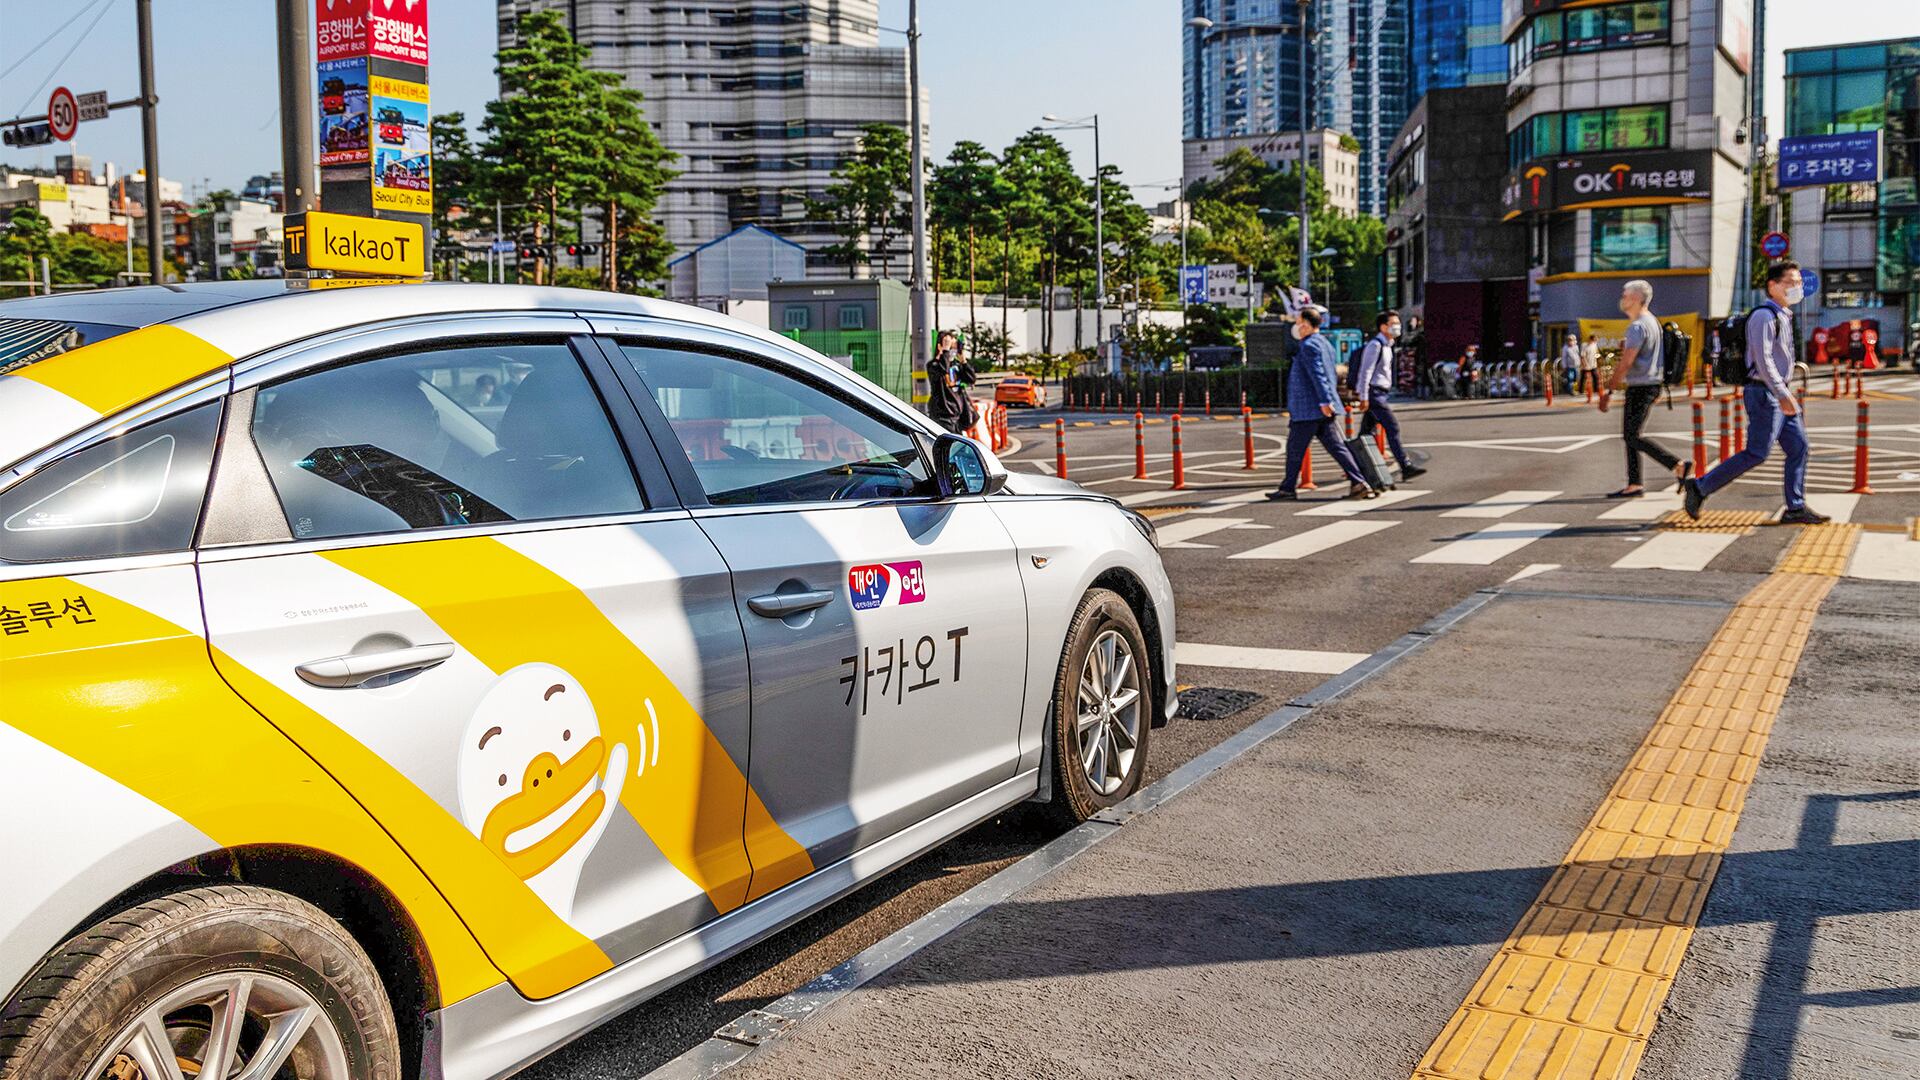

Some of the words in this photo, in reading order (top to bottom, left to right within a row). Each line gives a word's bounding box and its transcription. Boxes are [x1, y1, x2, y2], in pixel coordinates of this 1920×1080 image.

[319, 17, 366, 44] 공항버스
[373, 15, 427, 48] 공항버스
[319, 43, 349, 55] AIRPORT
[350, 41, 366, 51] BUS
[374, 41, 409, 57] AIRPORT
[410, 48, 427, 60] BUS
[53, 103, 72, 127] 50
[1805, 157, 1856, 177] 주차장
[1573, 172, 1614, 194] OK
[375, 190, 397, 203] Seoul
[399, 192, 413, 206] City
[415, 194, 430, 206] Bus
[324, 226, 410, 263] kakaoT
[851, 568, 880, 600] 개인
[0, 595, 96, 637] 솔루션
[839, 634, 940, 716] 카카오
[947, 626, 969, 683] T
